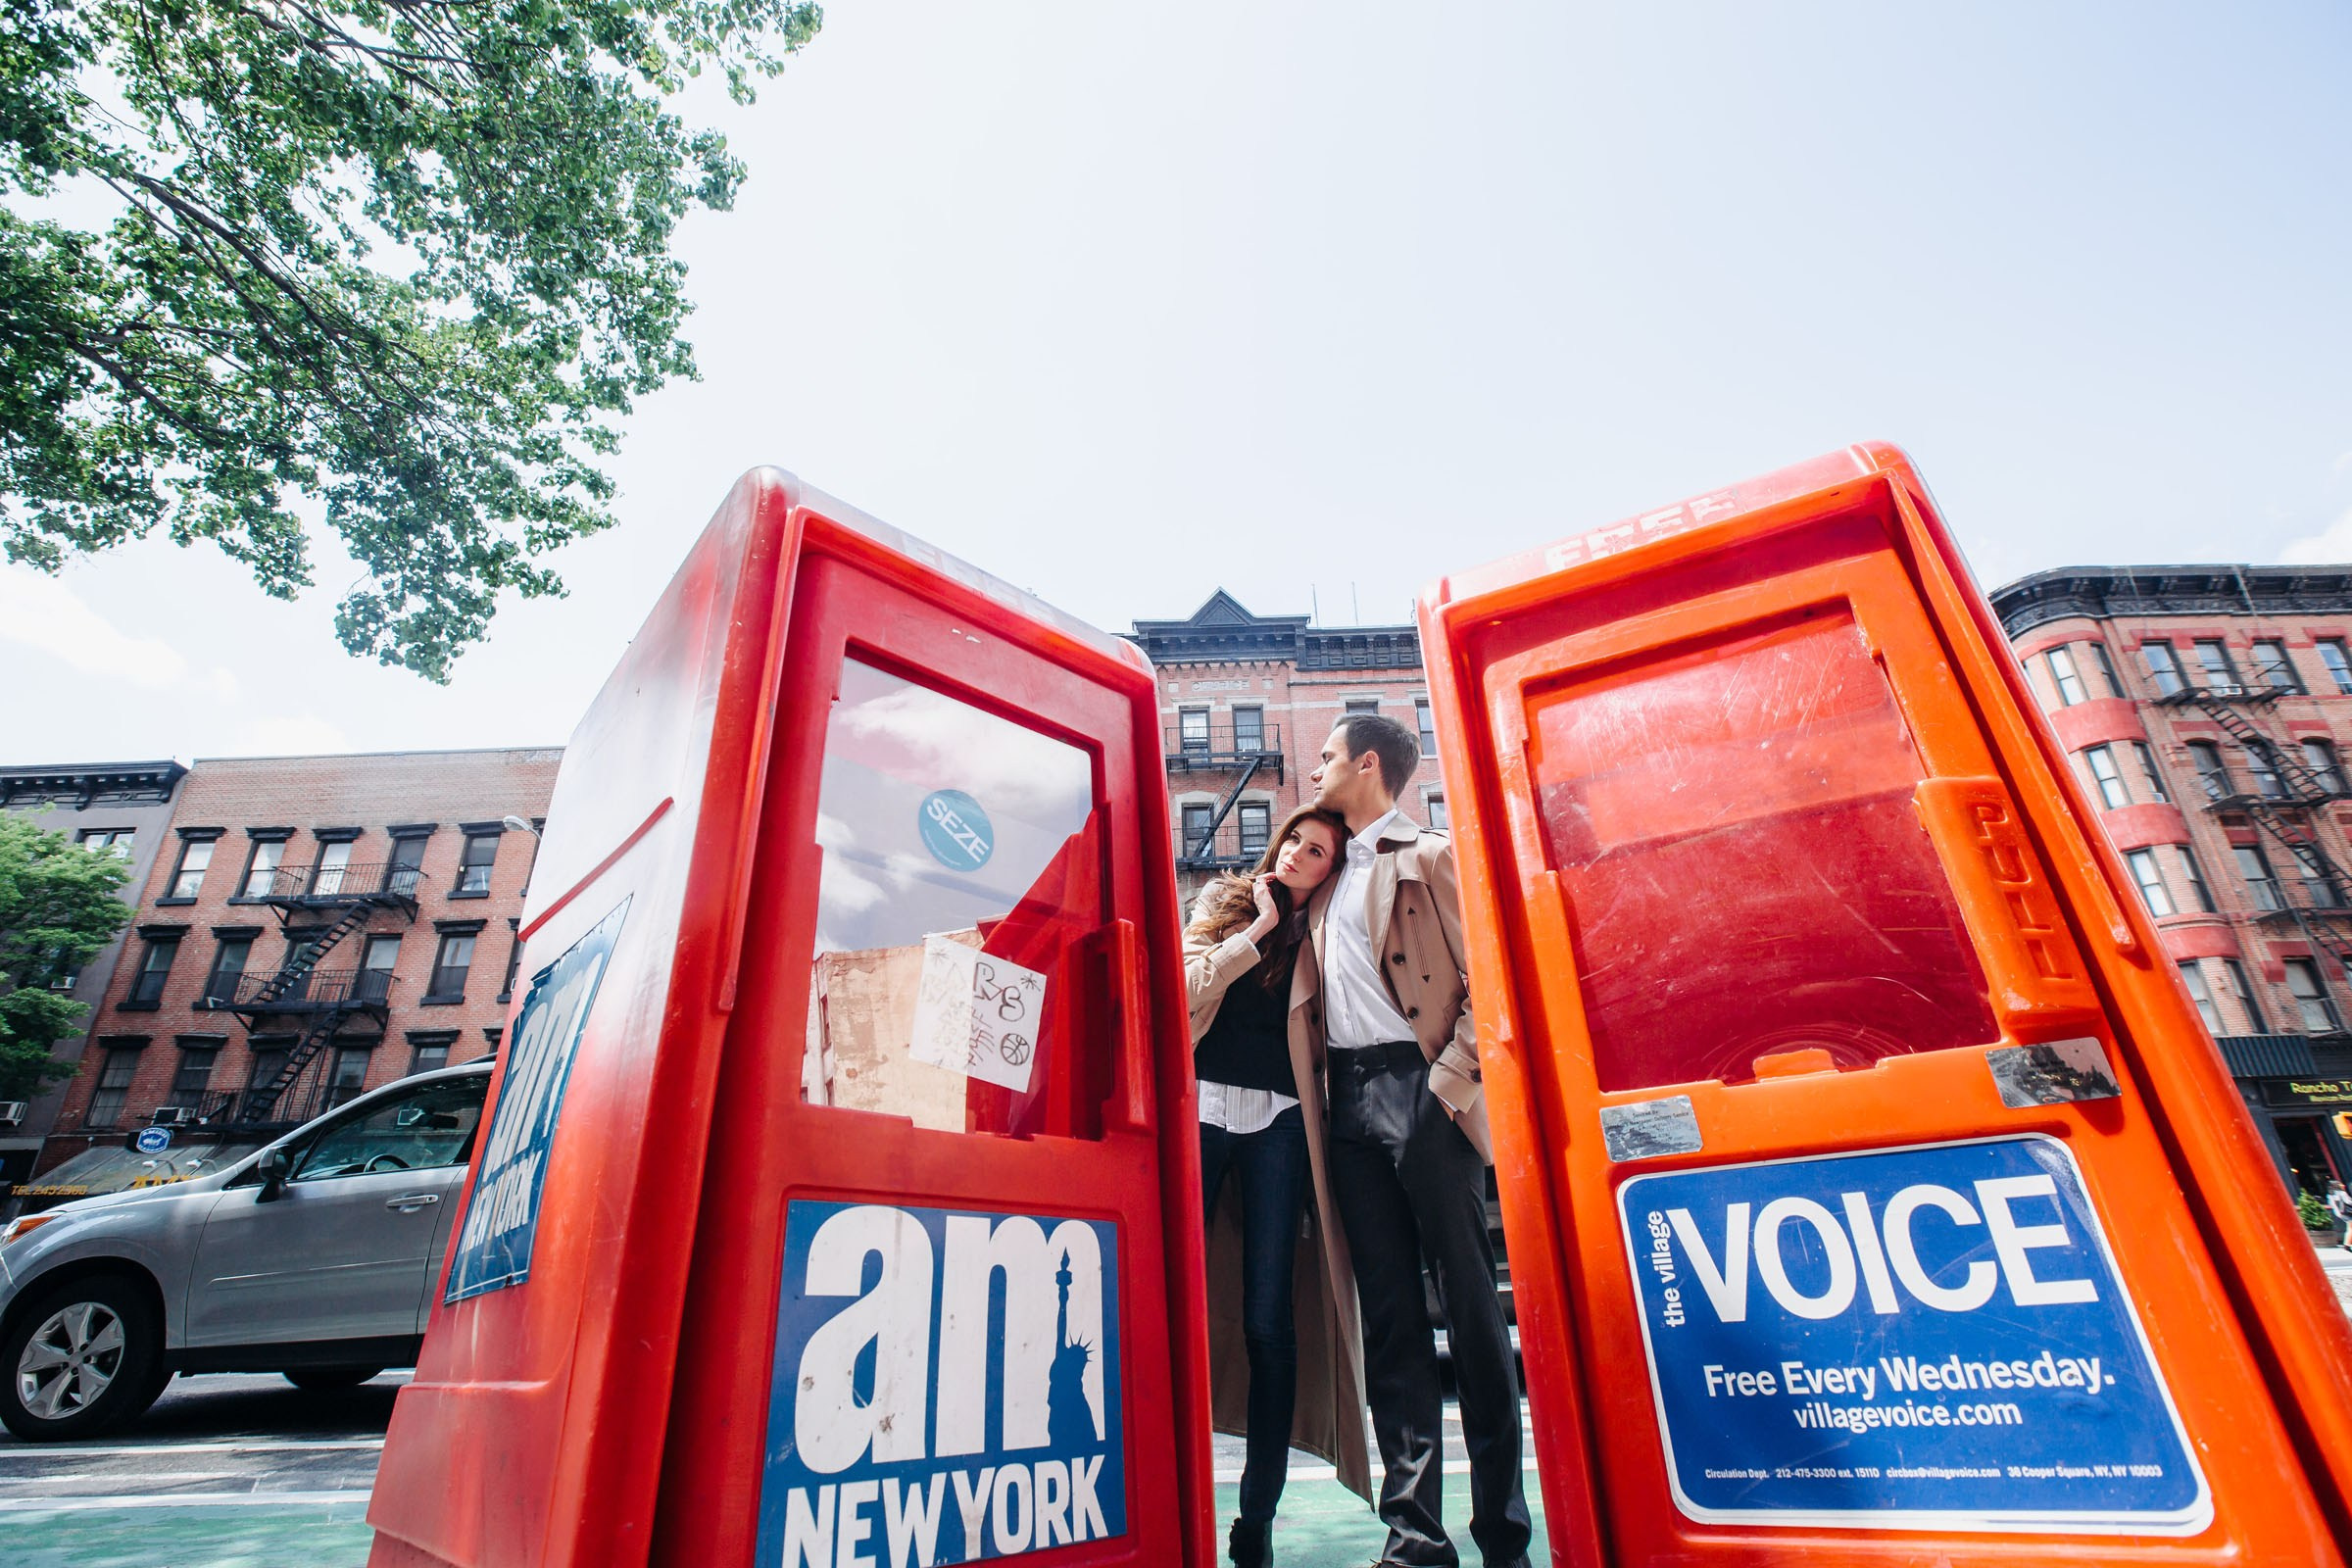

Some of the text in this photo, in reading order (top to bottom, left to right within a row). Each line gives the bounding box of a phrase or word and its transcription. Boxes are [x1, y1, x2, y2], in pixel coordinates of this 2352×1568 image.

[927, 798, 990, 863] SEZE
[1967, 802, 2076, 981] PULL
[2290, 1081, 2340, 1094] Rancho
[1647, 1210, 1686, 1328] the village
[1665, 1174, 2099, 1322] VOICE
[795, 1205, 1105, 1474] am
[1703, 1350, 2116, 1399] Free Every Wednesday.
[1792, 1399, 2023, 1434] villagevoice.com
[1705, 1468, 1747, 1479] Circulation
[1748, 1469, 1769, 1480] Dept.
[1776, 1467, 1837, 1479] 212-475-3300
[1838, 1469, 1854, 1478] ext.
[1855, 1467, 1880, 1478] 15110
[2022, 1466, 2056, 1479] Cooper
[2112, 1465, 2129, 1477] NY
